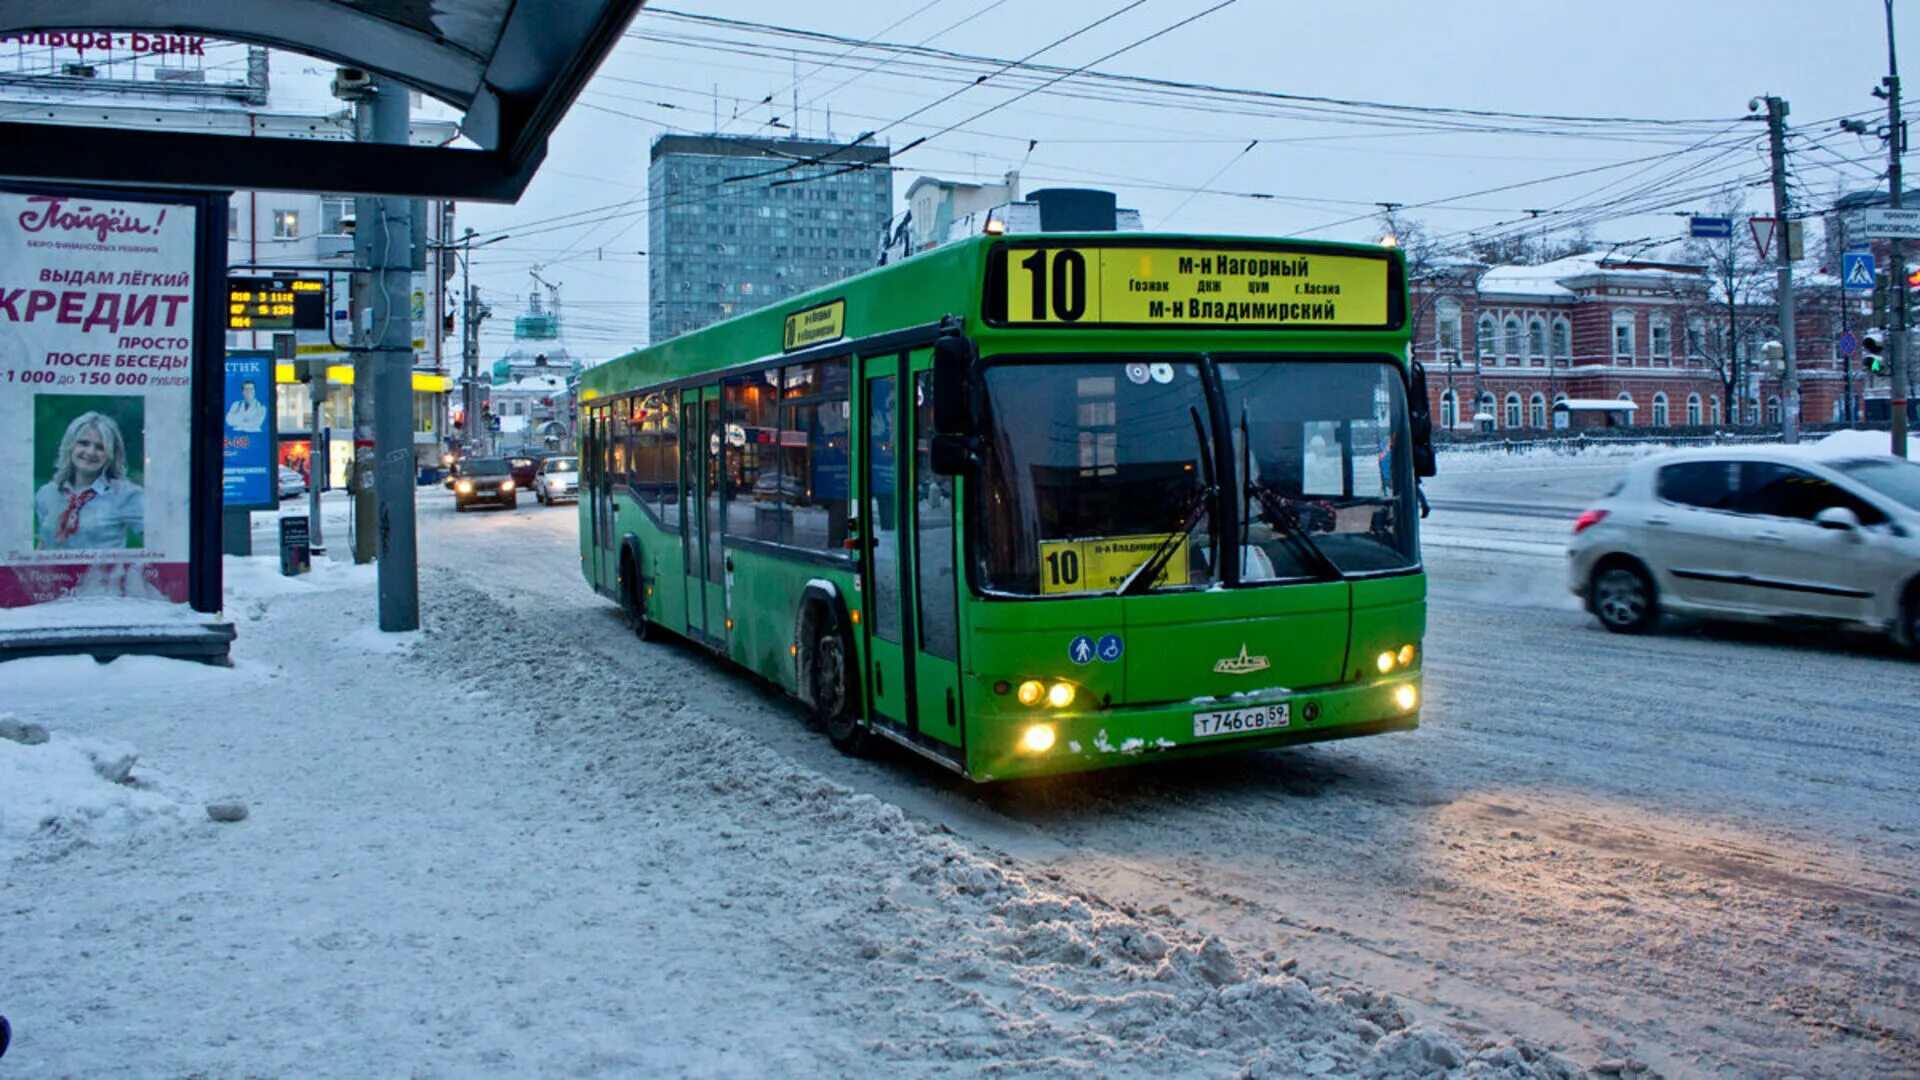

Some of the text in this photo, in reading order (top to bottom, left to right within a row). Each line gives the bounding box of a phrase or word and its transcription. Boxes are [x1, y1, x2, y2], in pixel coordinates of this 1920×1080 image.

[1216, 255, 1309, 277] Нагорный
[40, 269, 189, 288] ВЫДАМ ЛЁГКИЙ
[1022, 248, 1086, 321] 10
[1129, 279, 1169, 292] Гознак
[1248, 281, 1269, 293] ЦУМ
[1304, 284, 1340, 295] Хасана
[0, 288, 189, 333] КРЕДИТ
[1189, 298, 1335, 321] Владимирский
[118, 336, 188, 349] ПРОСТО
[46, 353, 188, 369] ПОСЛЕ БЕСЕДЫ
[1046, 550, 1079, 585] 10
